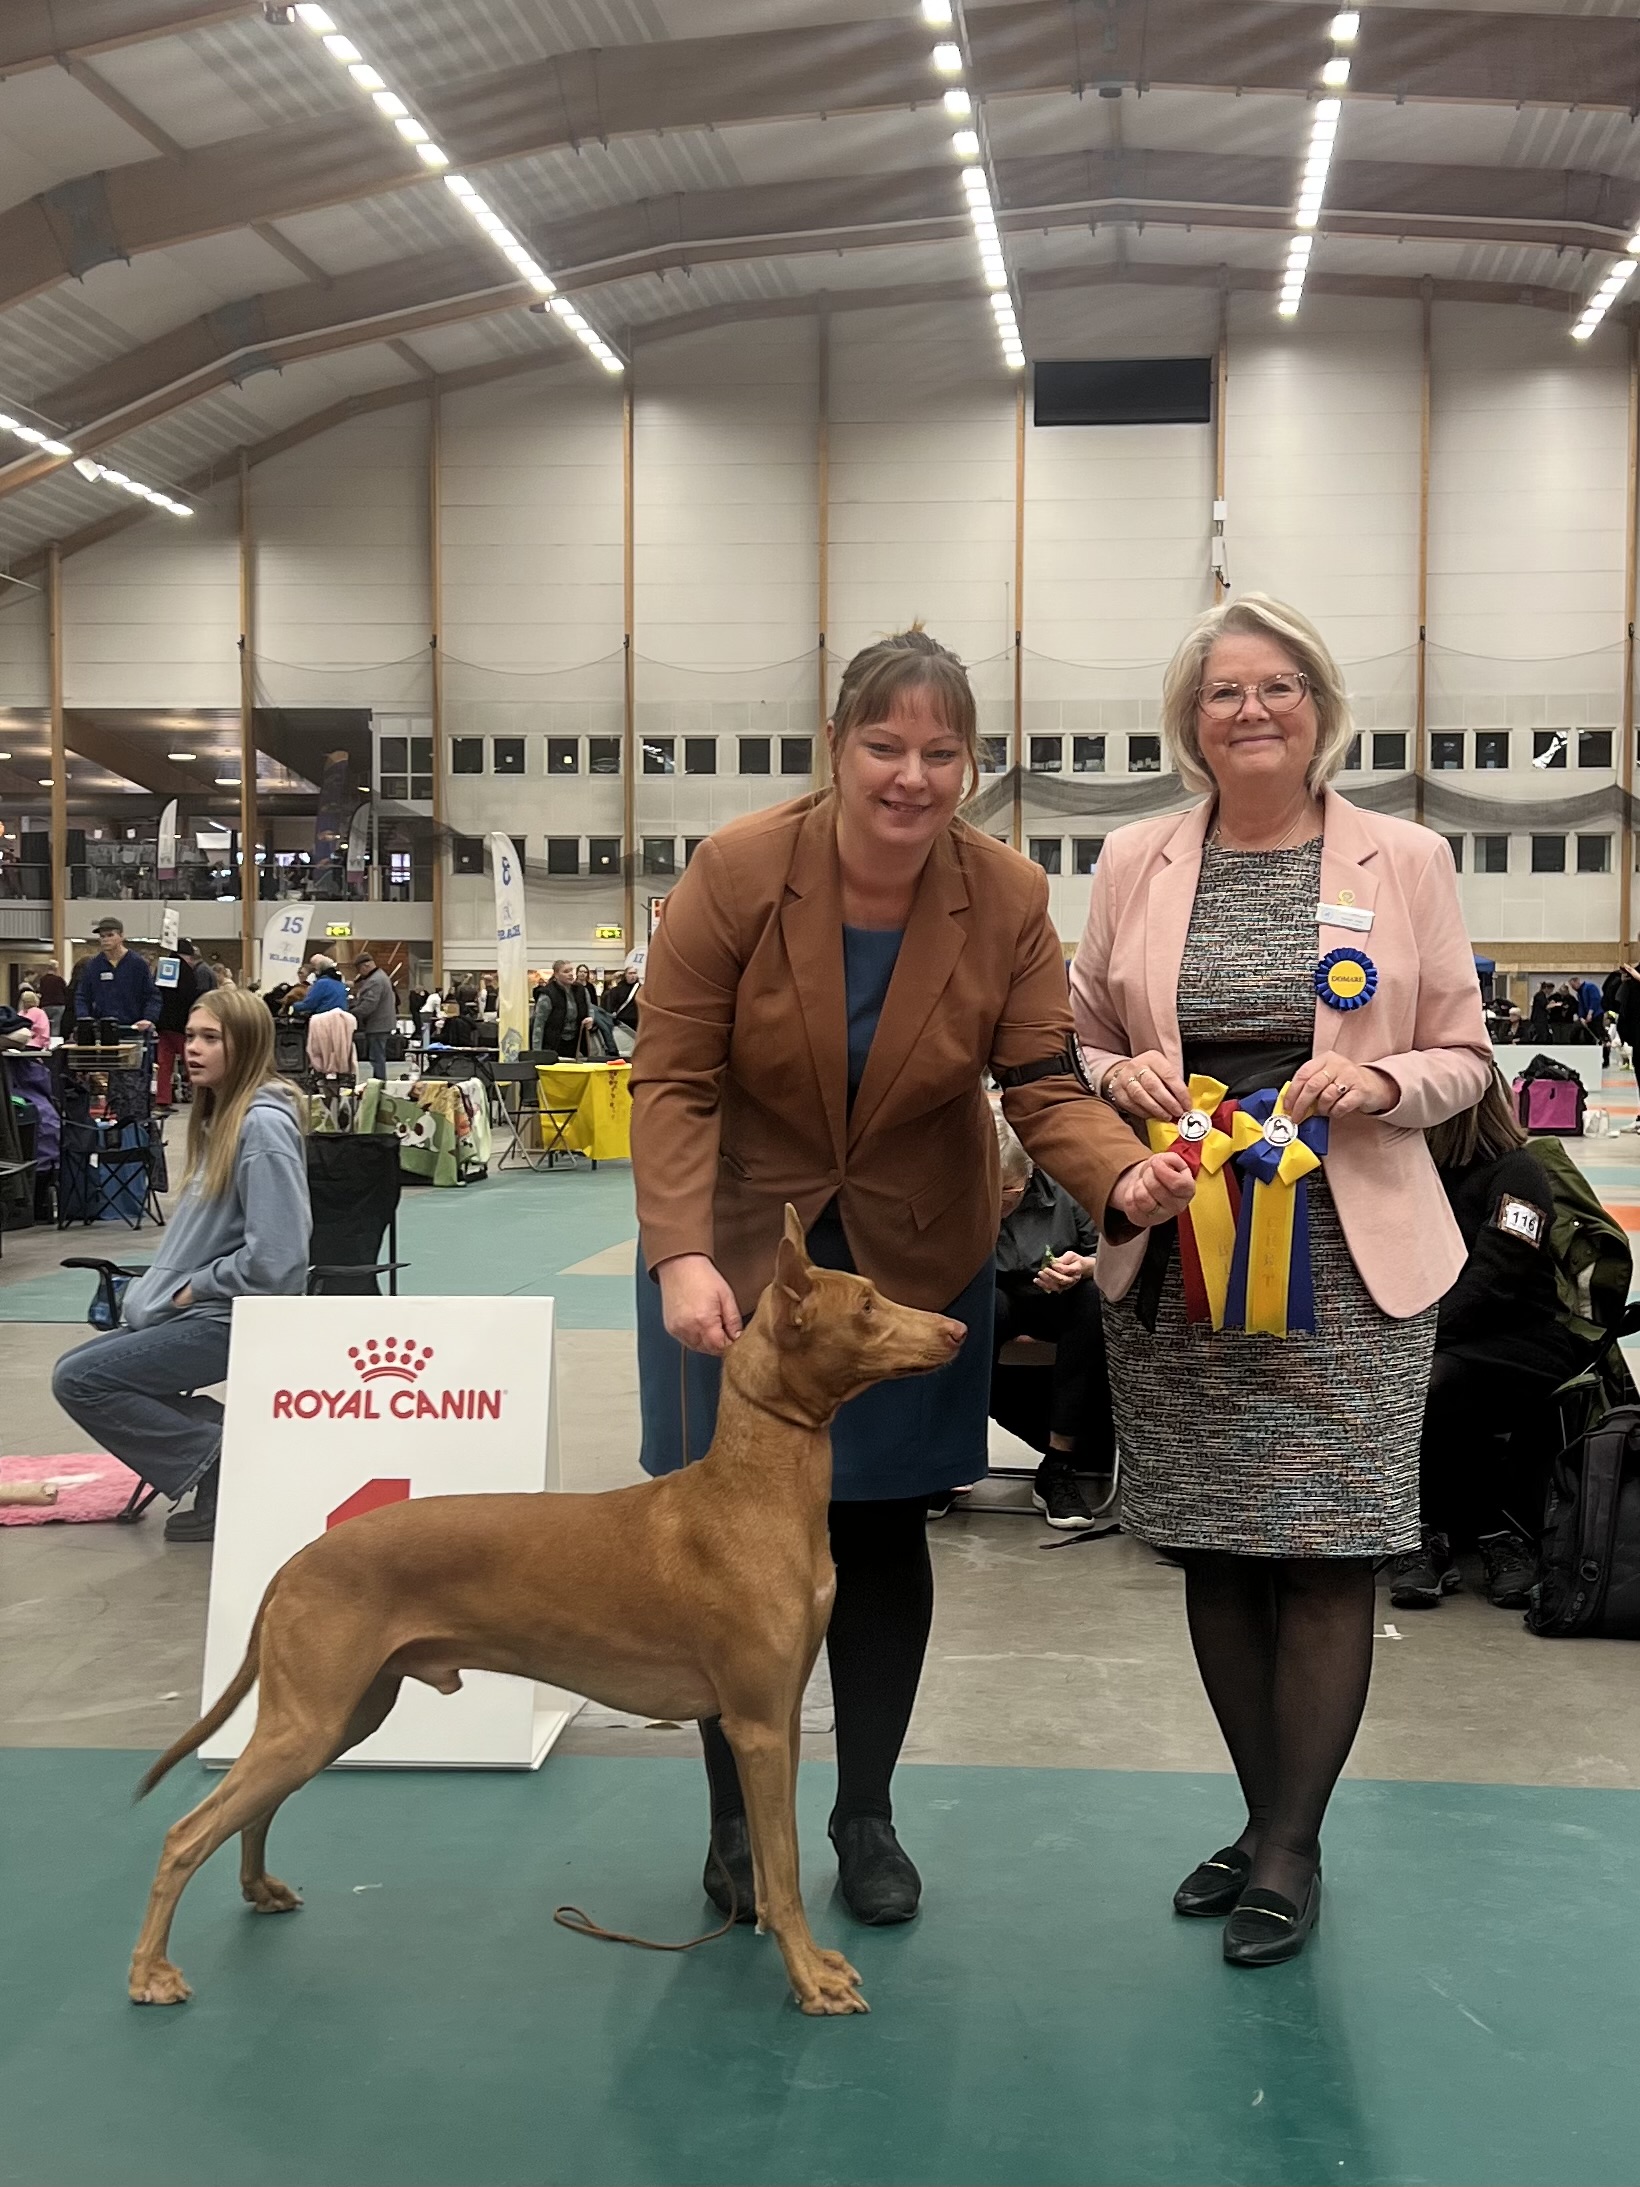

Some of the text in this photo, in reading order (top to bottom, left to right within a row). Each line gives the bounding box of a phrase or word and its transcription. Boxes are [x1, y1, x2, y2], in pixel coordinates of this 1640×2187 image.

[281, 916, 304, 934] 15
[1331, 975, 1364, 983] DOMARE
[1513, 1211, 1537, 1232] 116
[273, 1389, 502, 1419] ROYAL CANIN
